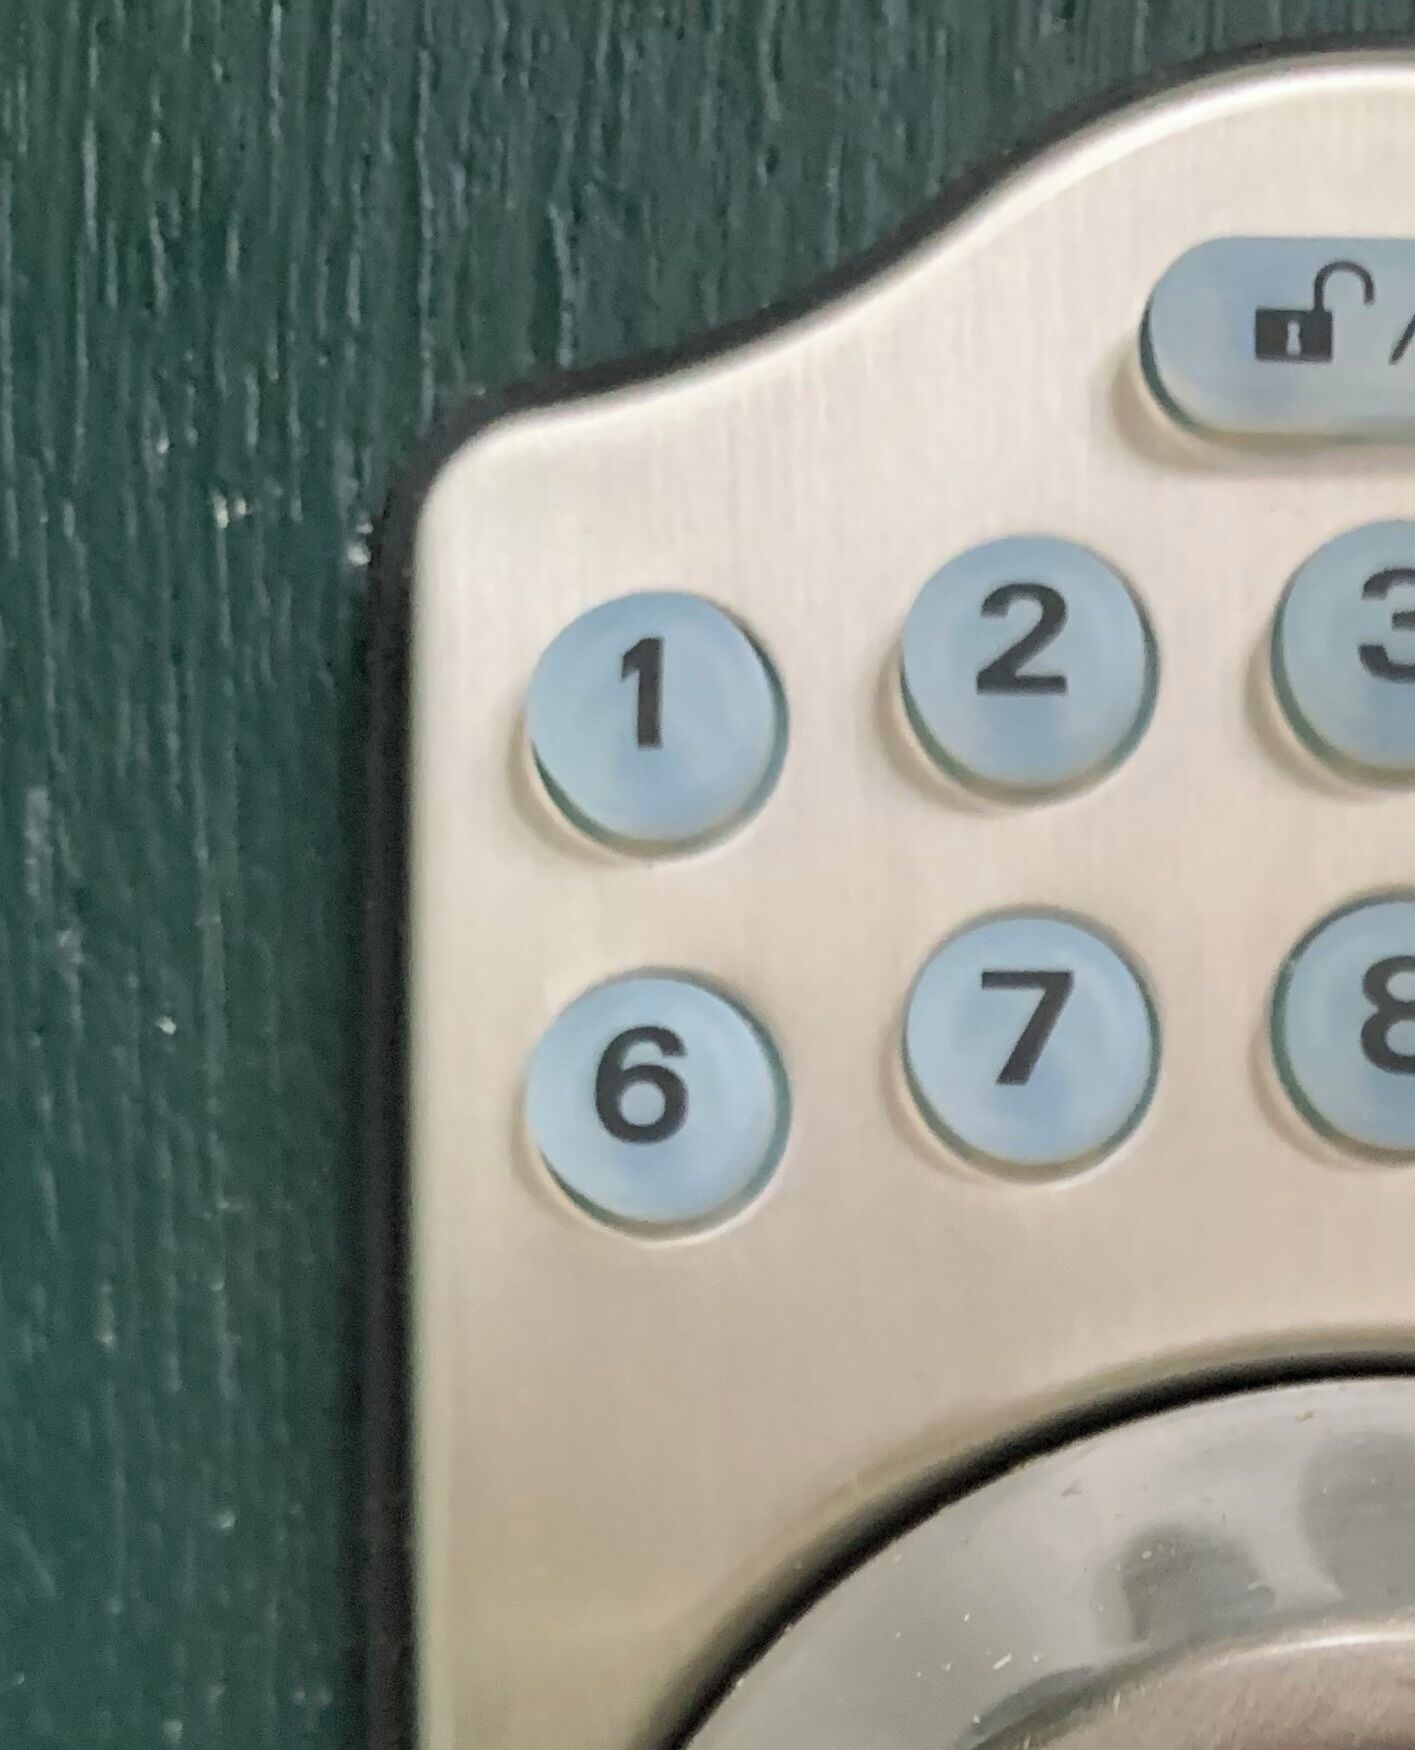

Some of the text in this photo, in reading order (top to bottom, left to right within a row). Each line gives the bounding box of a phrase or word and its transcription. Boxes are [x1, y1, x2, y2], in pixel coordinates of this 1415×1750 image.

[619, 635, 664, 750] 1
[974, 581, 1069, 698] 2
[592, 1024, 689, 1147] 6
[979, 968, 1074, 1088] 7
